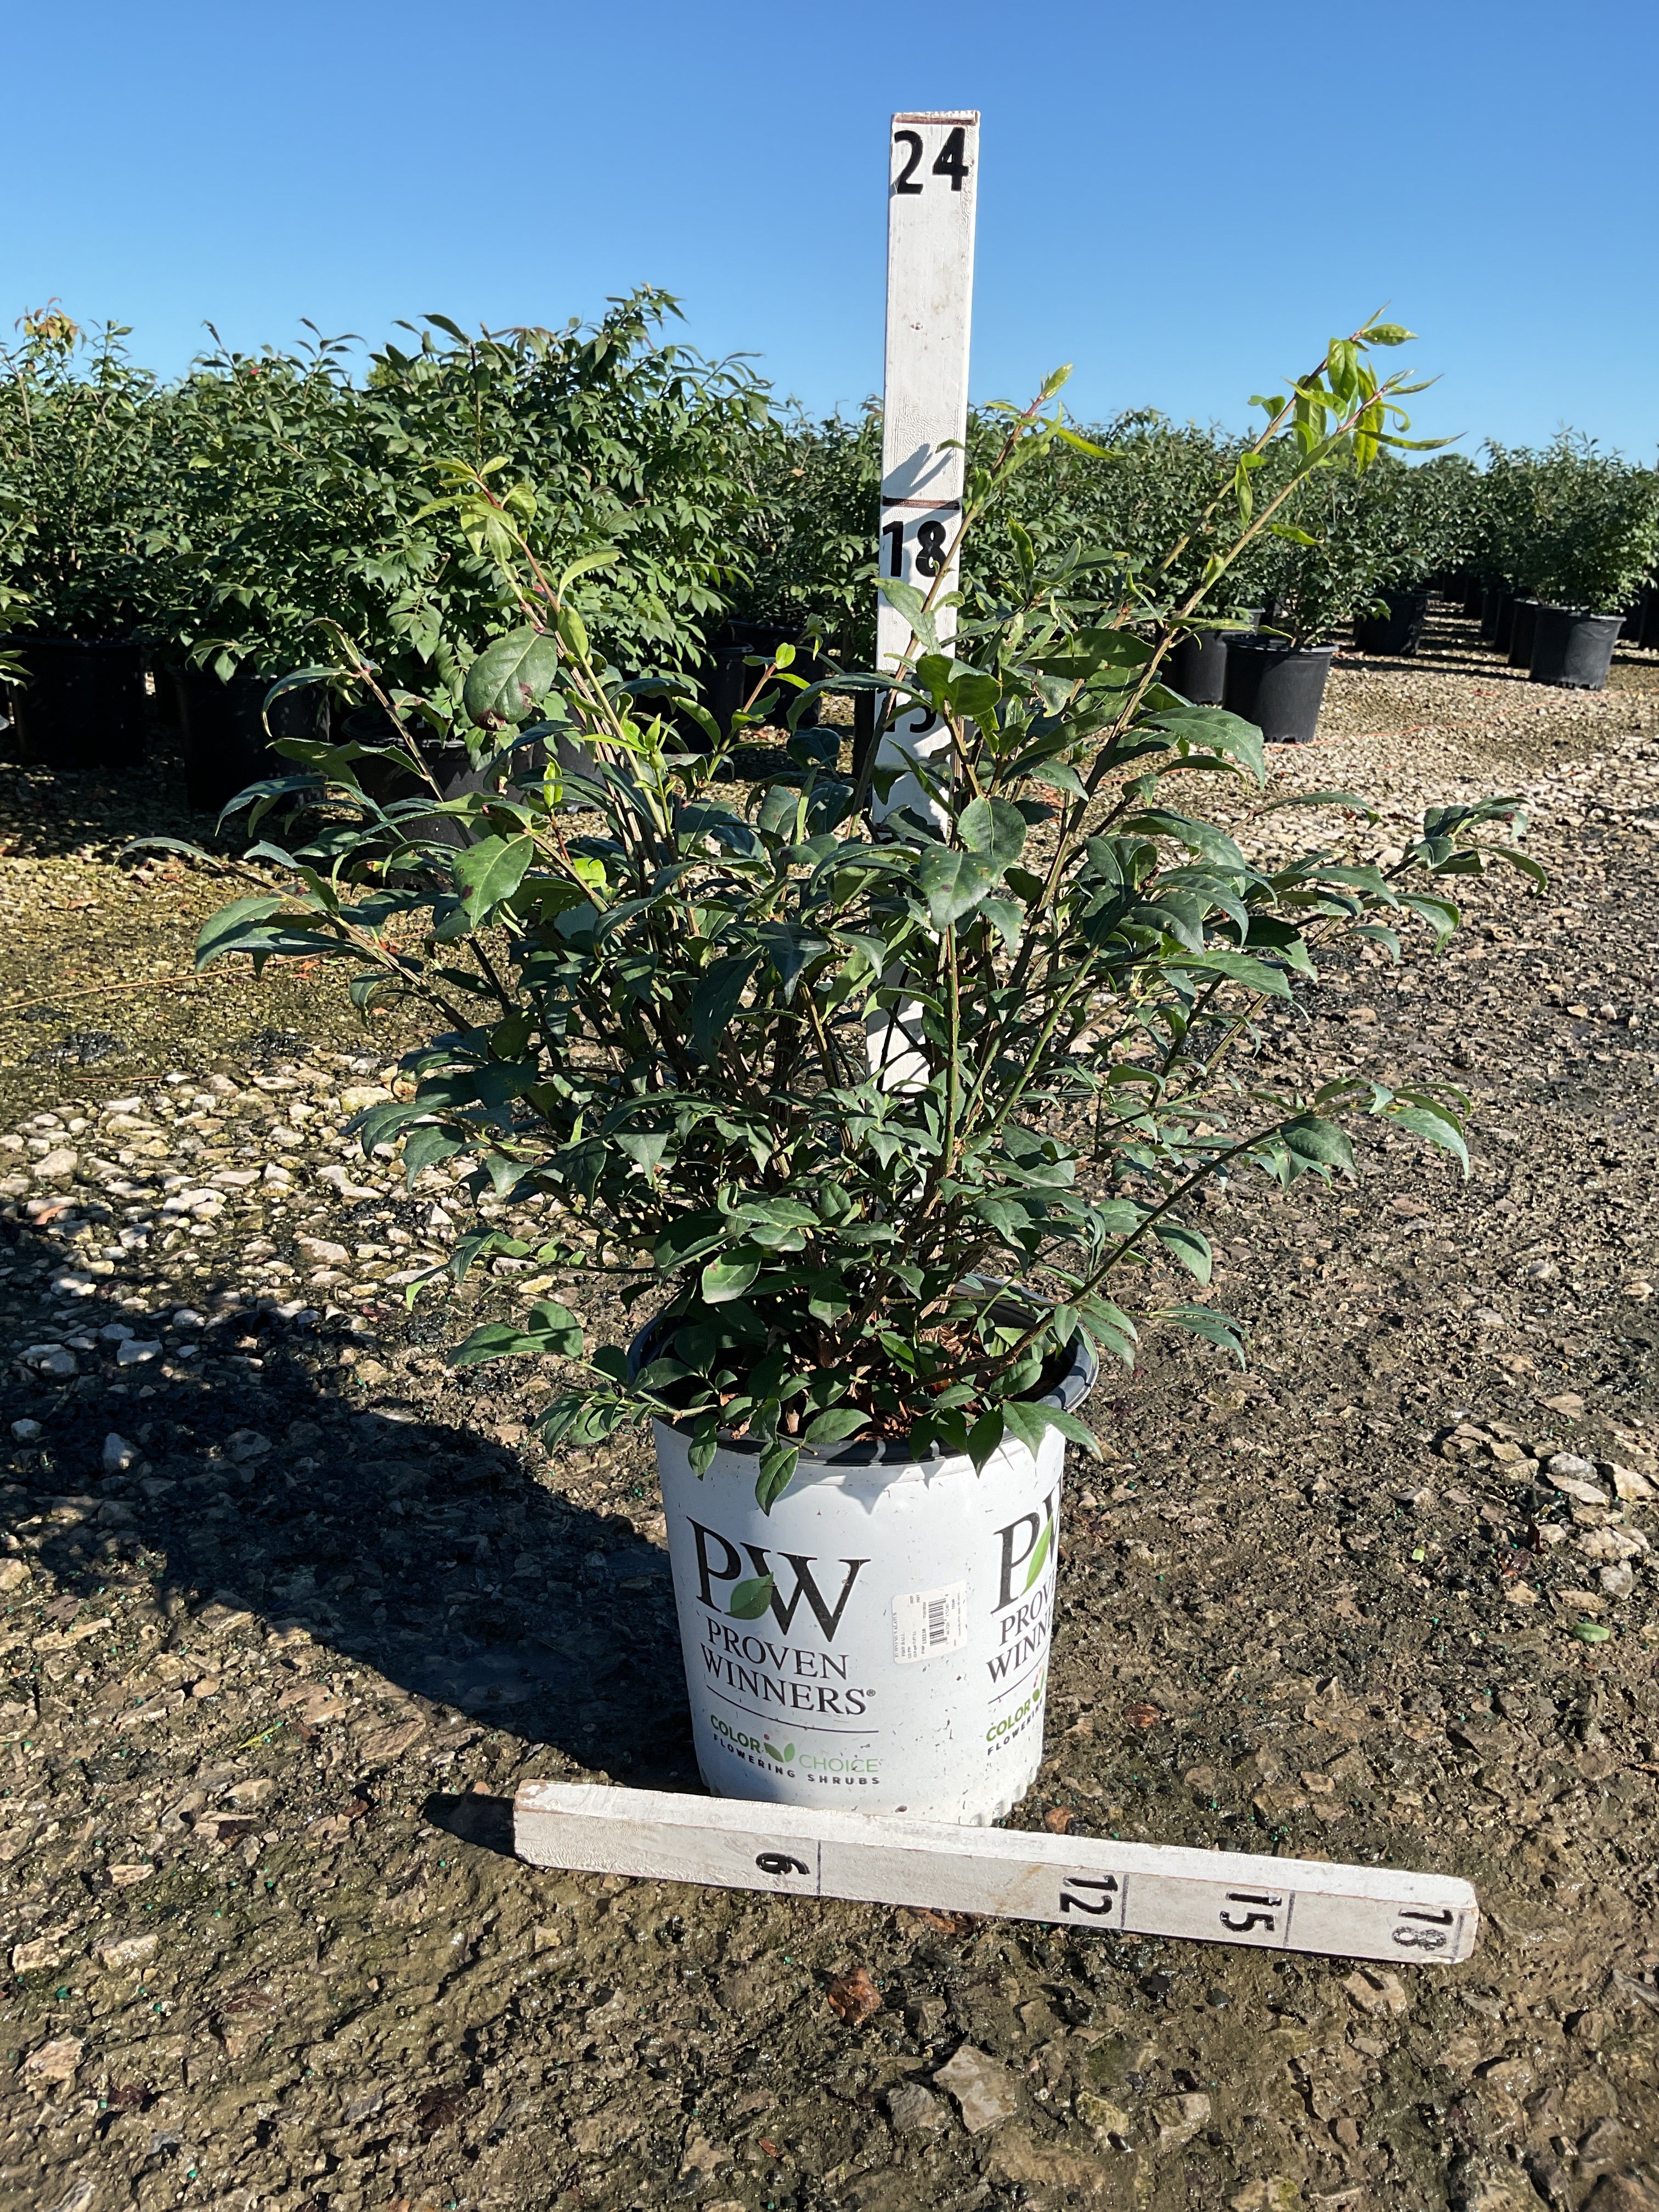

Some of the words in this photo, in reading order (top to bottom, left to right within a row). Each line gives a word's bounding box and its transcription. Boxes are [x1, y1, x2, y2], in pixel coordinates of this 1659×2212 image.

[894, 127, 969, 194] 24
[882, 521, 946, 577] 18
[686, 1516, 871, 1643] PW
[706, 1615, 850, 1680] PROVEN
[710, 1714, 764, 1754] COLOR
[799, 1754, 879, 1773] CHOICE
[986, 1698, 1031, 1742] COLOR
[713, 1733, 795, 1778] FLOWERING
[807, 1773, 881, 1785] SHRUBS
[1060, 1875, 1119, 1915] 12
[1220, 1891, 1283, 1932] 15
[1392, 1909, 1454, 1951] 18
